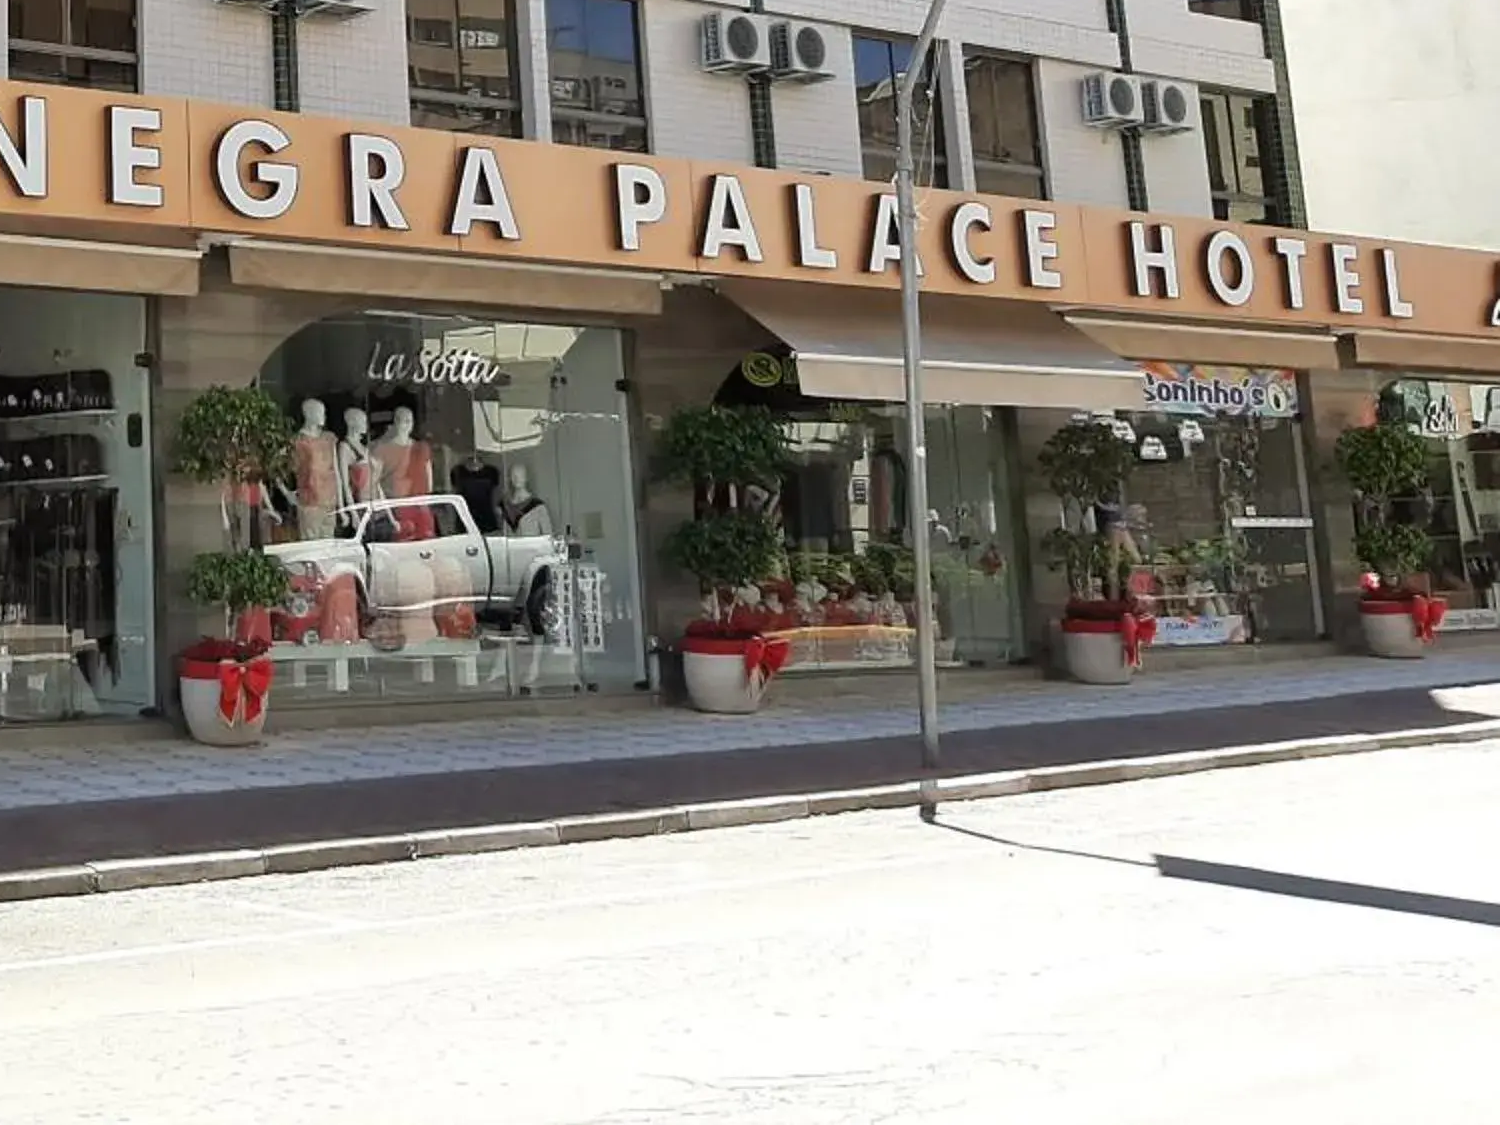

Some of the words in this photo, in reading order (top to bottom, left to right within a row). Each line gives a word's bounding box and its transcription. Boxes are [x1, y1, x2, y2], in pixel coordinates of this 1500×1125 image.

[613, 163, 1062, 288] PALACE
[1128, 221, 1413, 318] HOTEL
[368, 341, 411, 381] La
